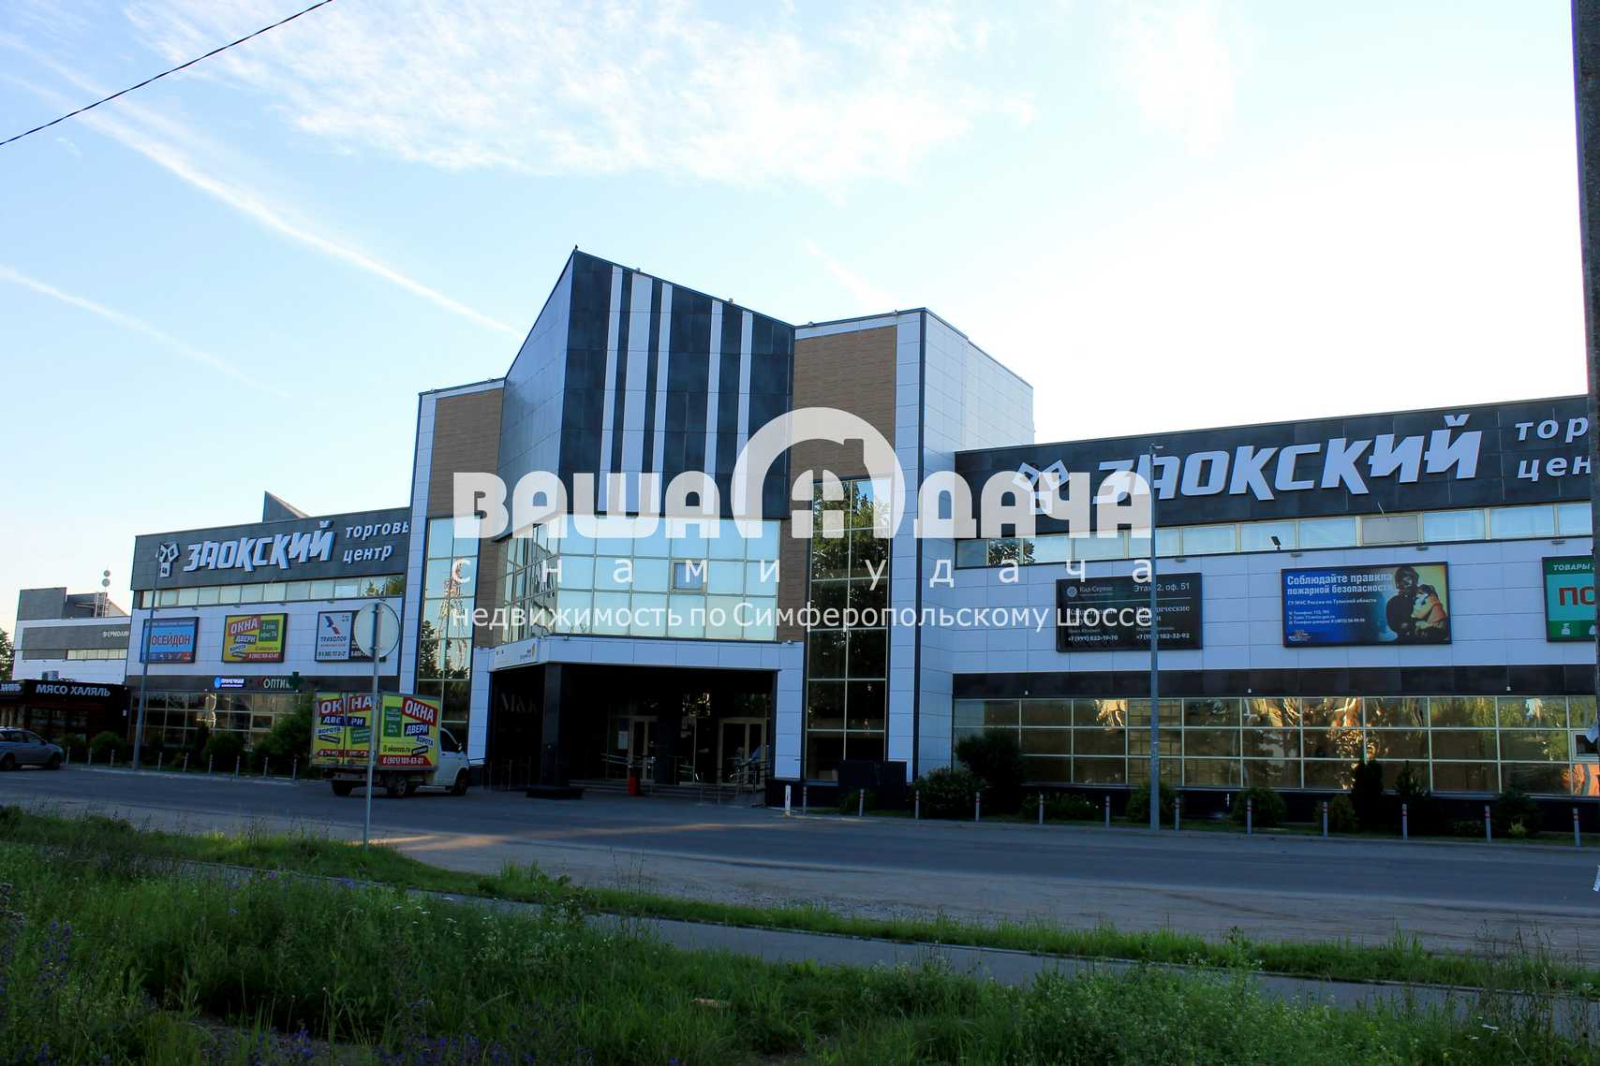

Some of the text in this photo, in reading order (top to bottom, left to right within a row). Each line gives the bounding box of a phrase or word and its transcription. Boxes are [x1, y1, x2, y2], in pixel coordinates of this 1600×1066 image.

[1093, 414, 1482, 504] ЗАОКСКИЙ
[183, 520, 336, 572] ЗАОКСКИЙ
[343, 545, 393, 563] центр
[1553, 563, 1590, 571] ТОВАРЫ
[1287, 572, 1393, 585] Соблюдайте правила
[1180, 582, 1190, 591] 51
[1287, 585, 1330, 595] пожарной
[231, 618, 258, 634] ОКНА
[150, 632, 191, 648] ОСЕЙДОН
[36, 684, 111, 697] МЯСО ХАЛЯЛЬ
[404, 699, 435, 723] ОКНА
[406, 724, 428, 736] ДВЕРИ
